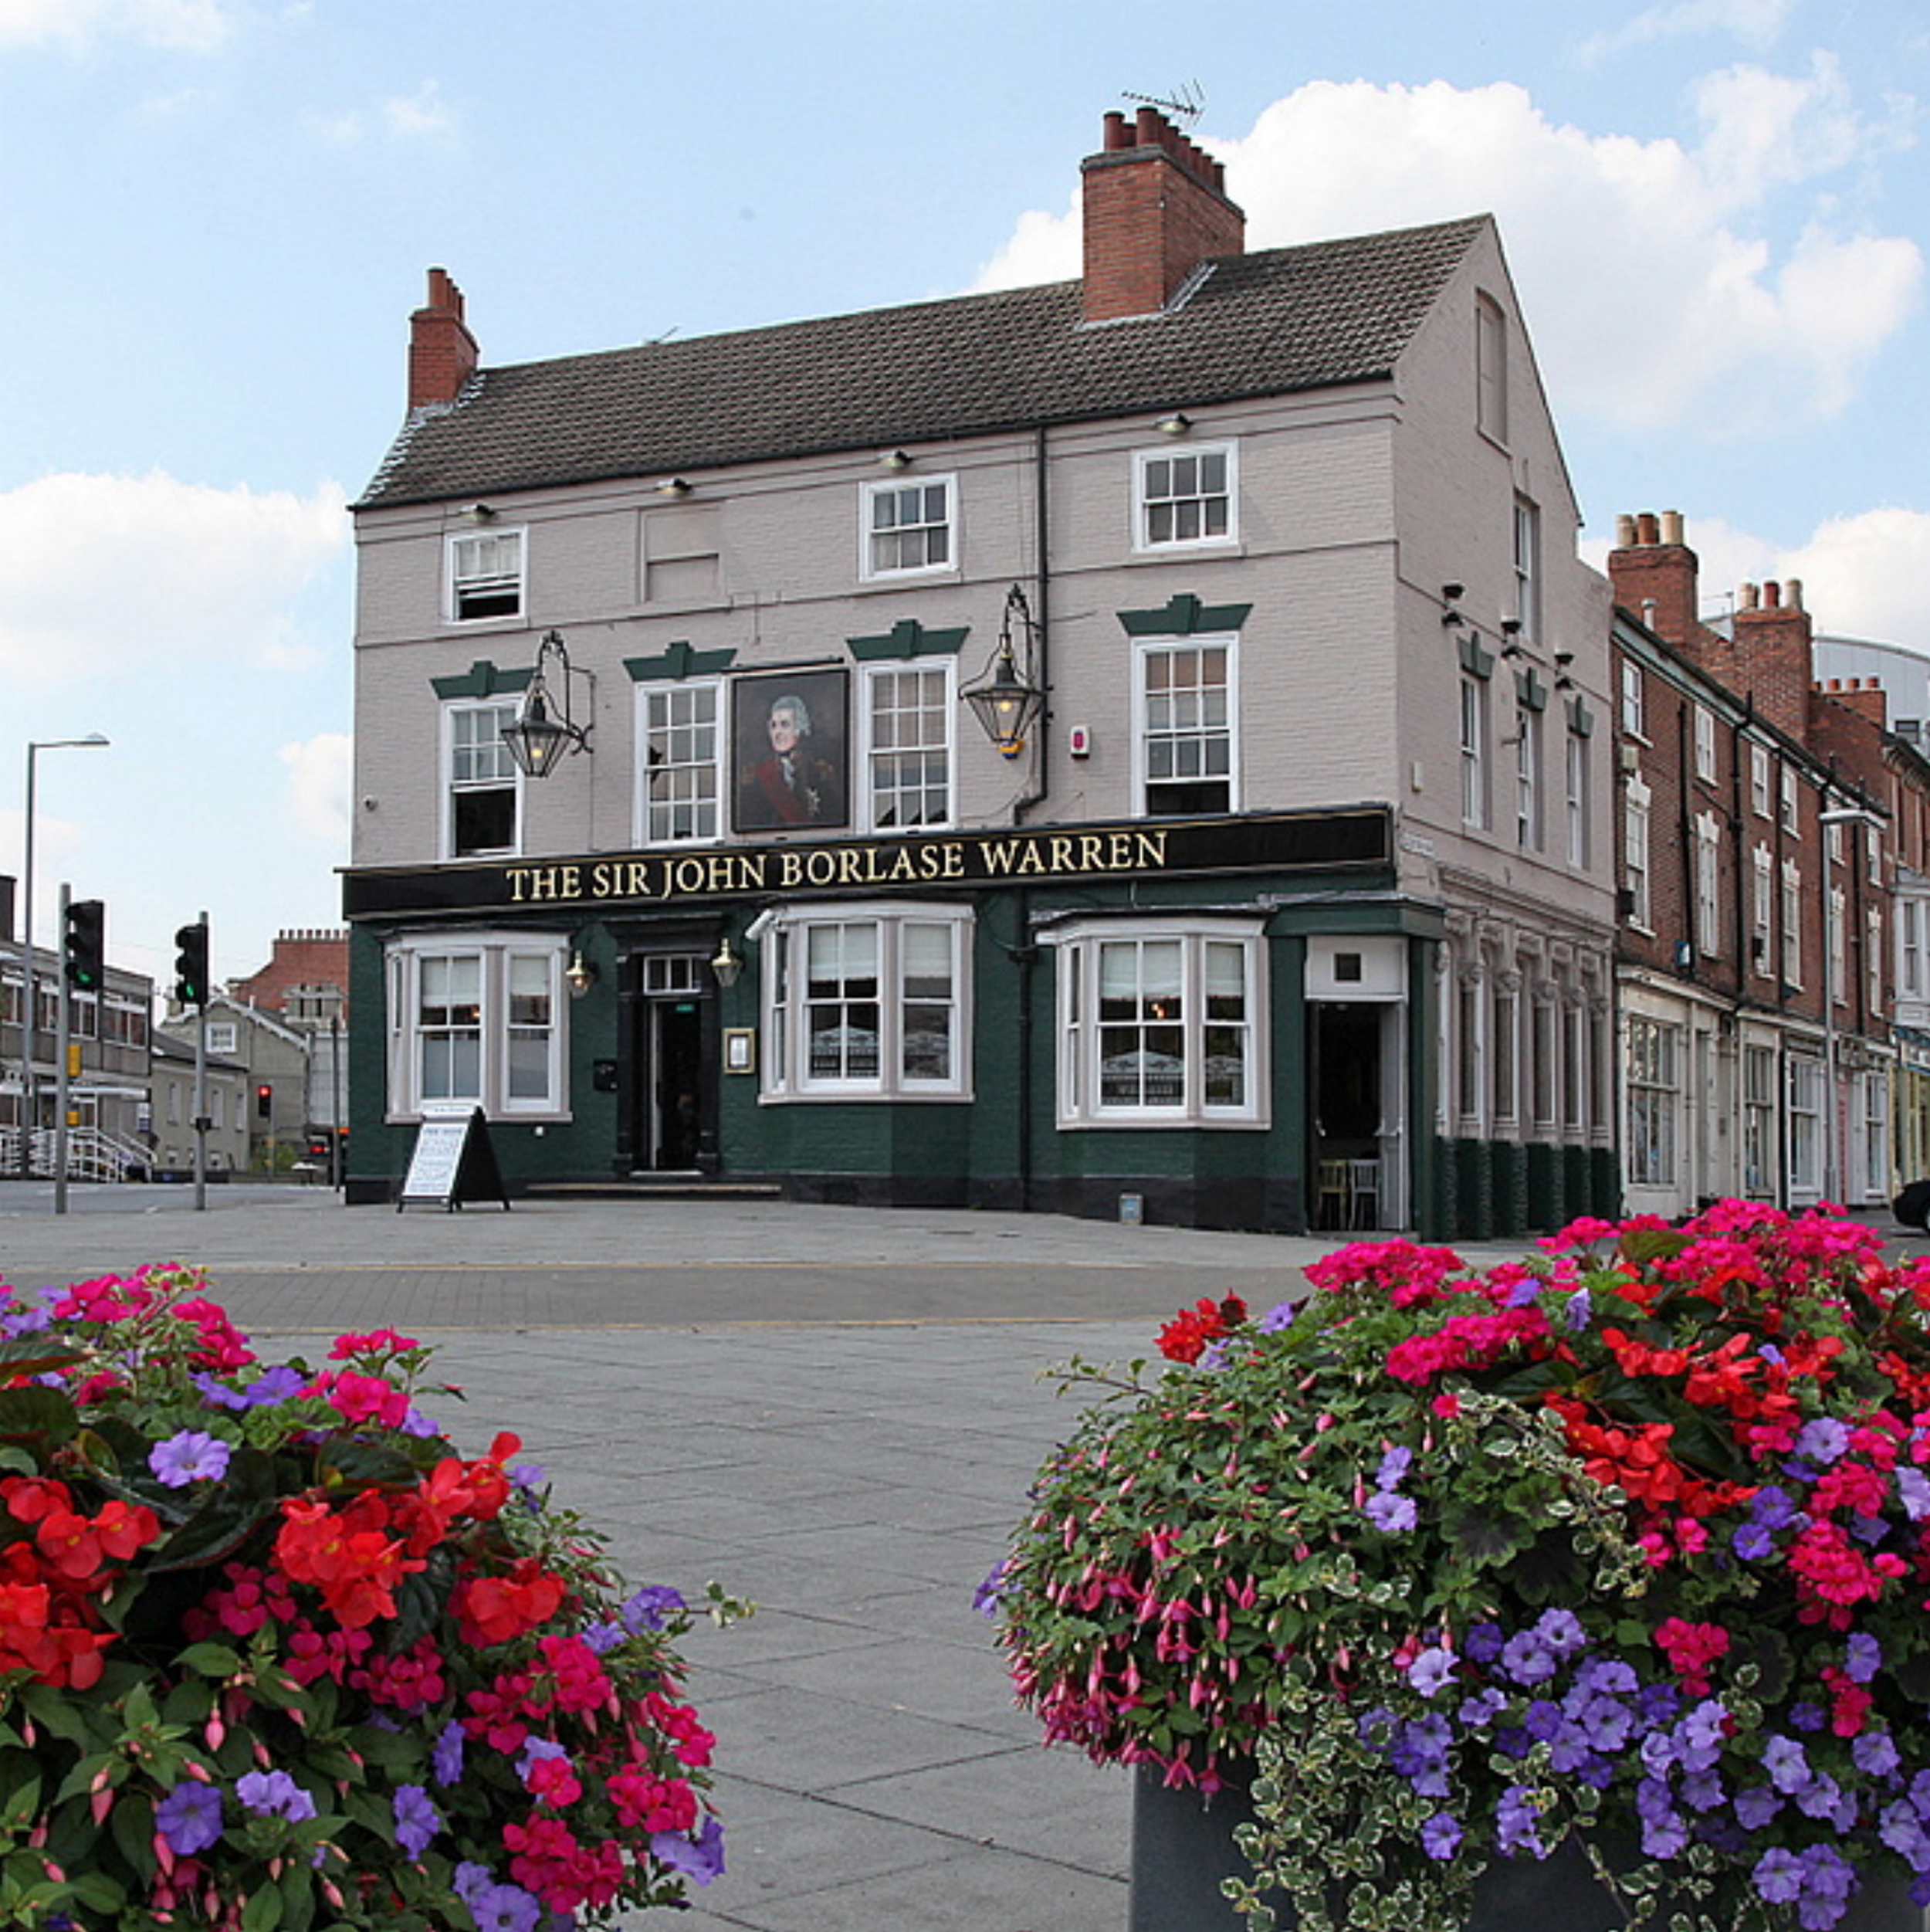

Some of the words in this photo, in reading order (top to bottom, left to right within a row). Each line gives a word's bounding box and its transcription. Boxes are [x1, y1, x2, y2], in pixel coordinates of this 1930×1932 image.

[506, 866, 581, 900] THE
[592, 863, 650, 896] SIR
[662, 856, 767, 900] JOHN
[780, 842, 964, 885] BORLASE
[979, 832, 1168, 874] WARREN
